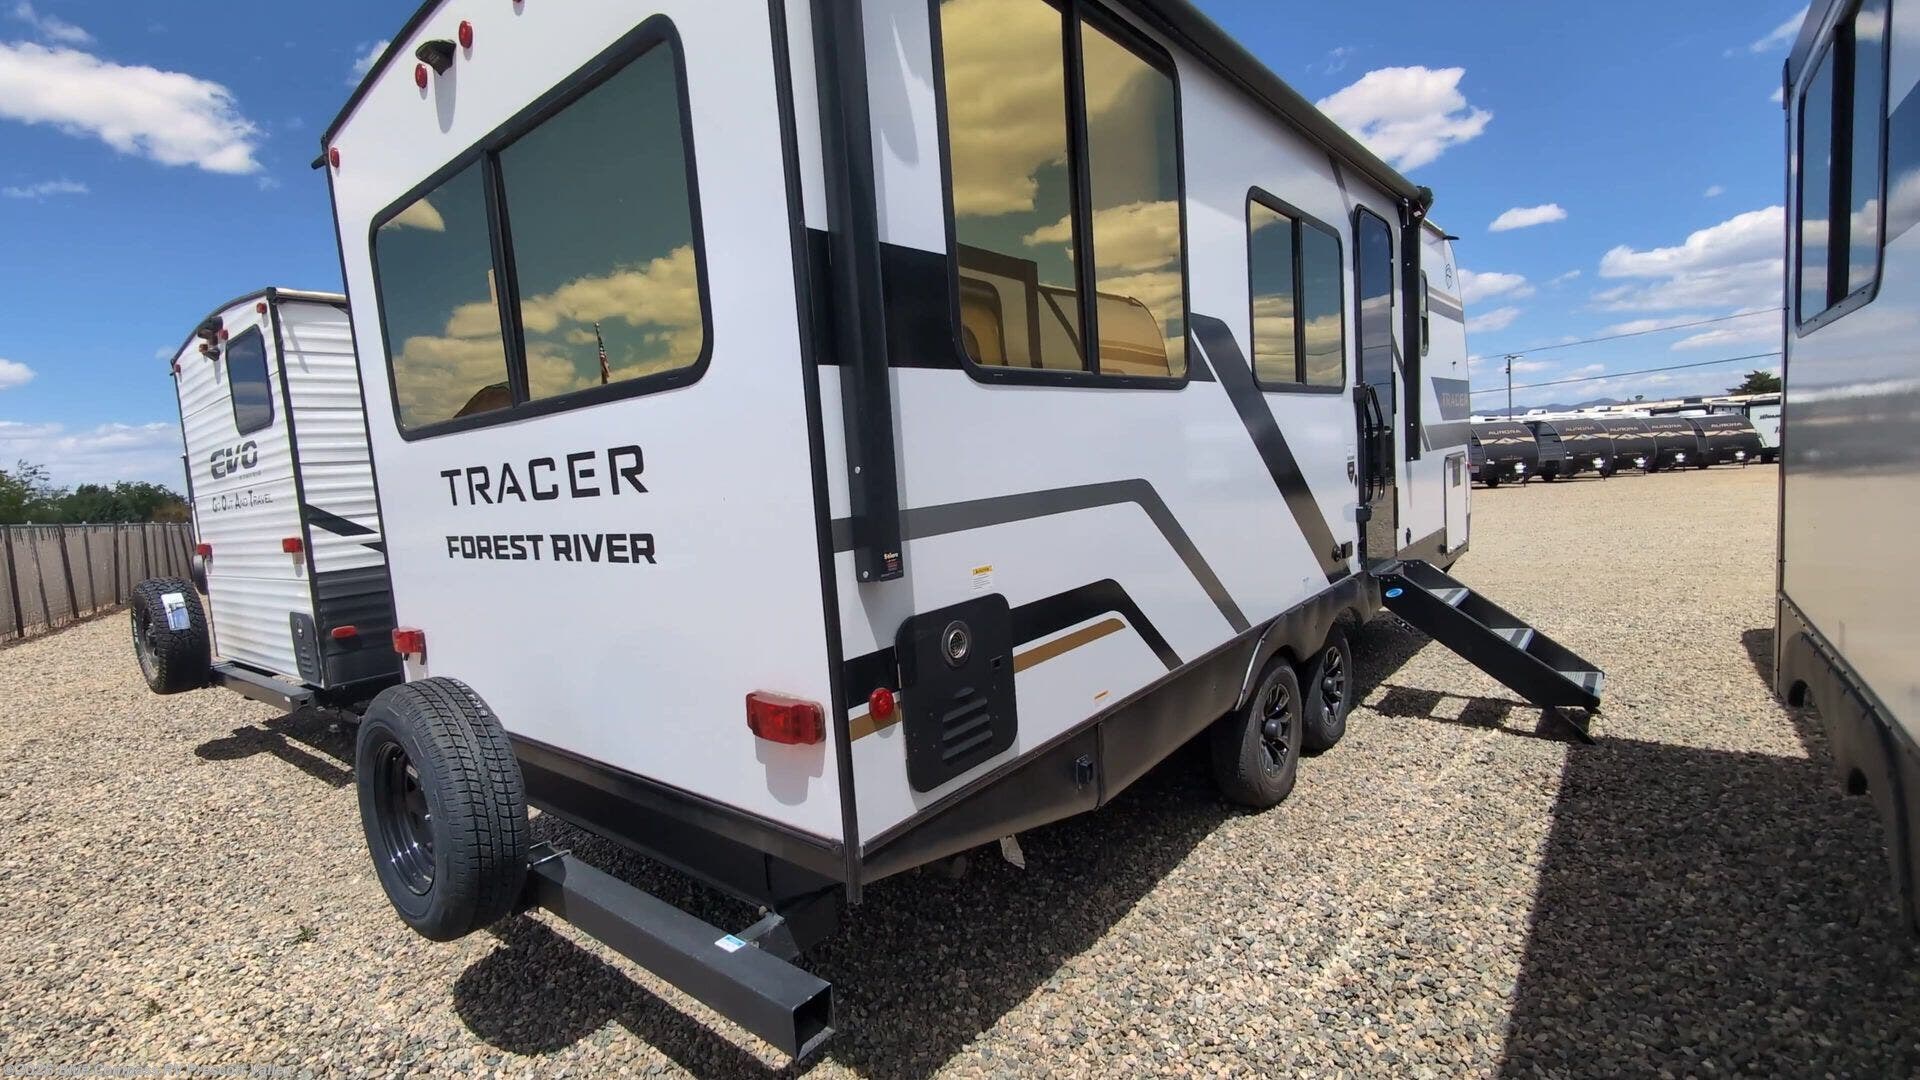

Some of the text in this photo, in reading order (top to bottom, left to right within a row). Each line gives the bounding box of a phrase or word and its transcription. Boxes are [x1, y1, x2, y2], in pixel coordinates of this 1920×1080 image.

[210, 440, 257, 480] EVO
[440, 444, 648, 506] TRACER
[446, 533, 657, 564] FOREST RIVER
